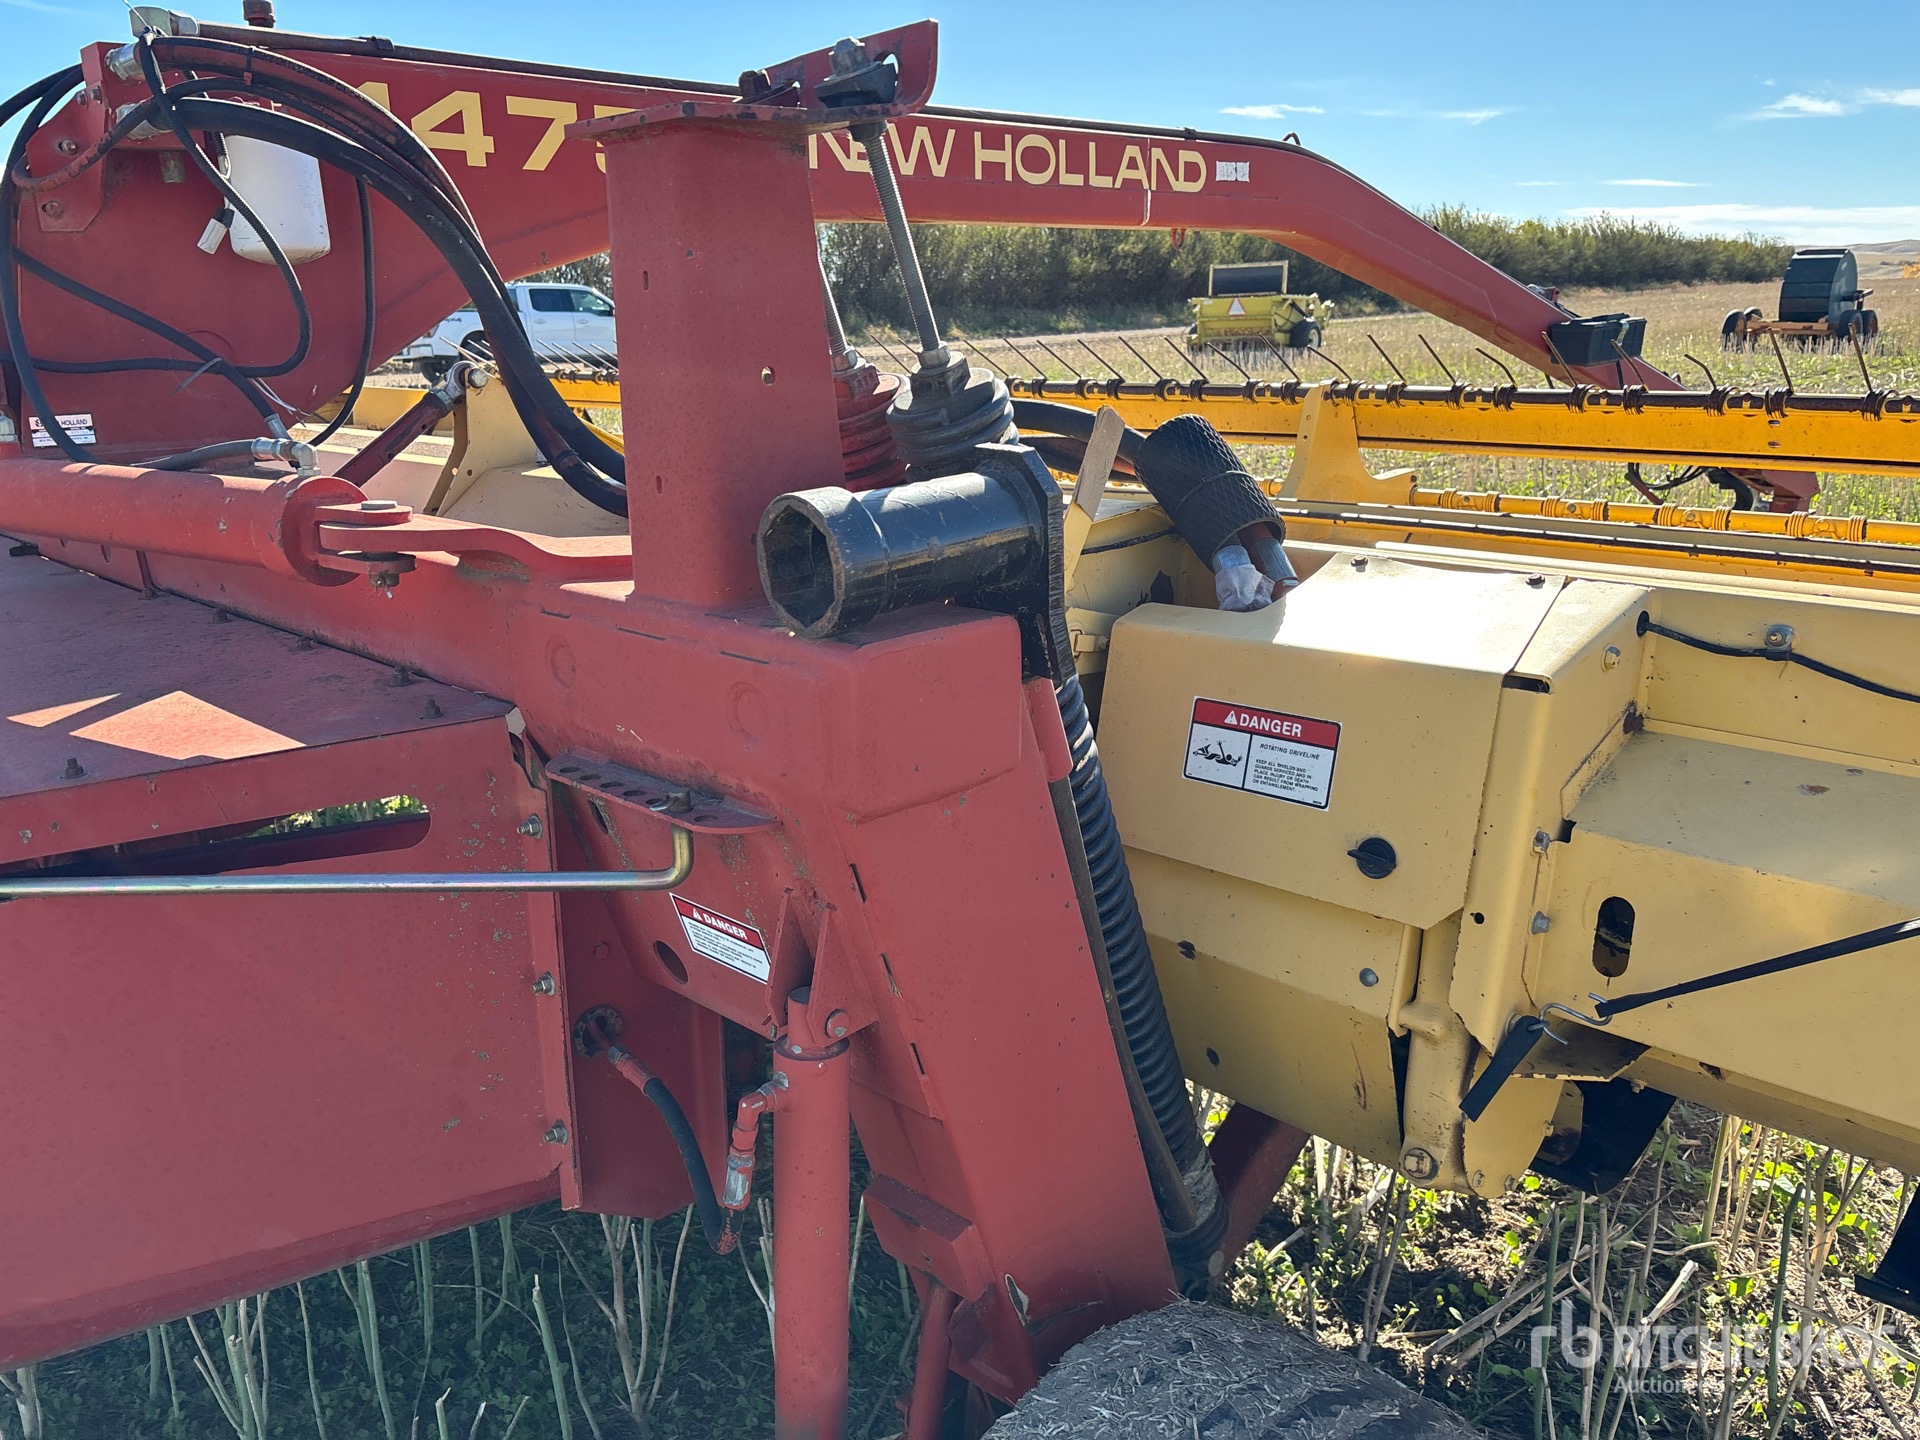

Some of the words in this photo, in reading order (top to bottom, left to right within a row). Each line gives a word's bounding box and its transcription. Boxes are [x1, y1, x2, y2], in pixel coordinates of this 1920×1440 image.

[974, 131, 1207, 193] HOLLAND
[1240, 713, 1302, 737] DANGER
[1259, 743, 1288, 753] ROTATING
[1289, 749, 1320, 760] DRIVELINE
[1273, 768, 1295, 776] SERVICED
[702, 913, 748, 940] DANGER
